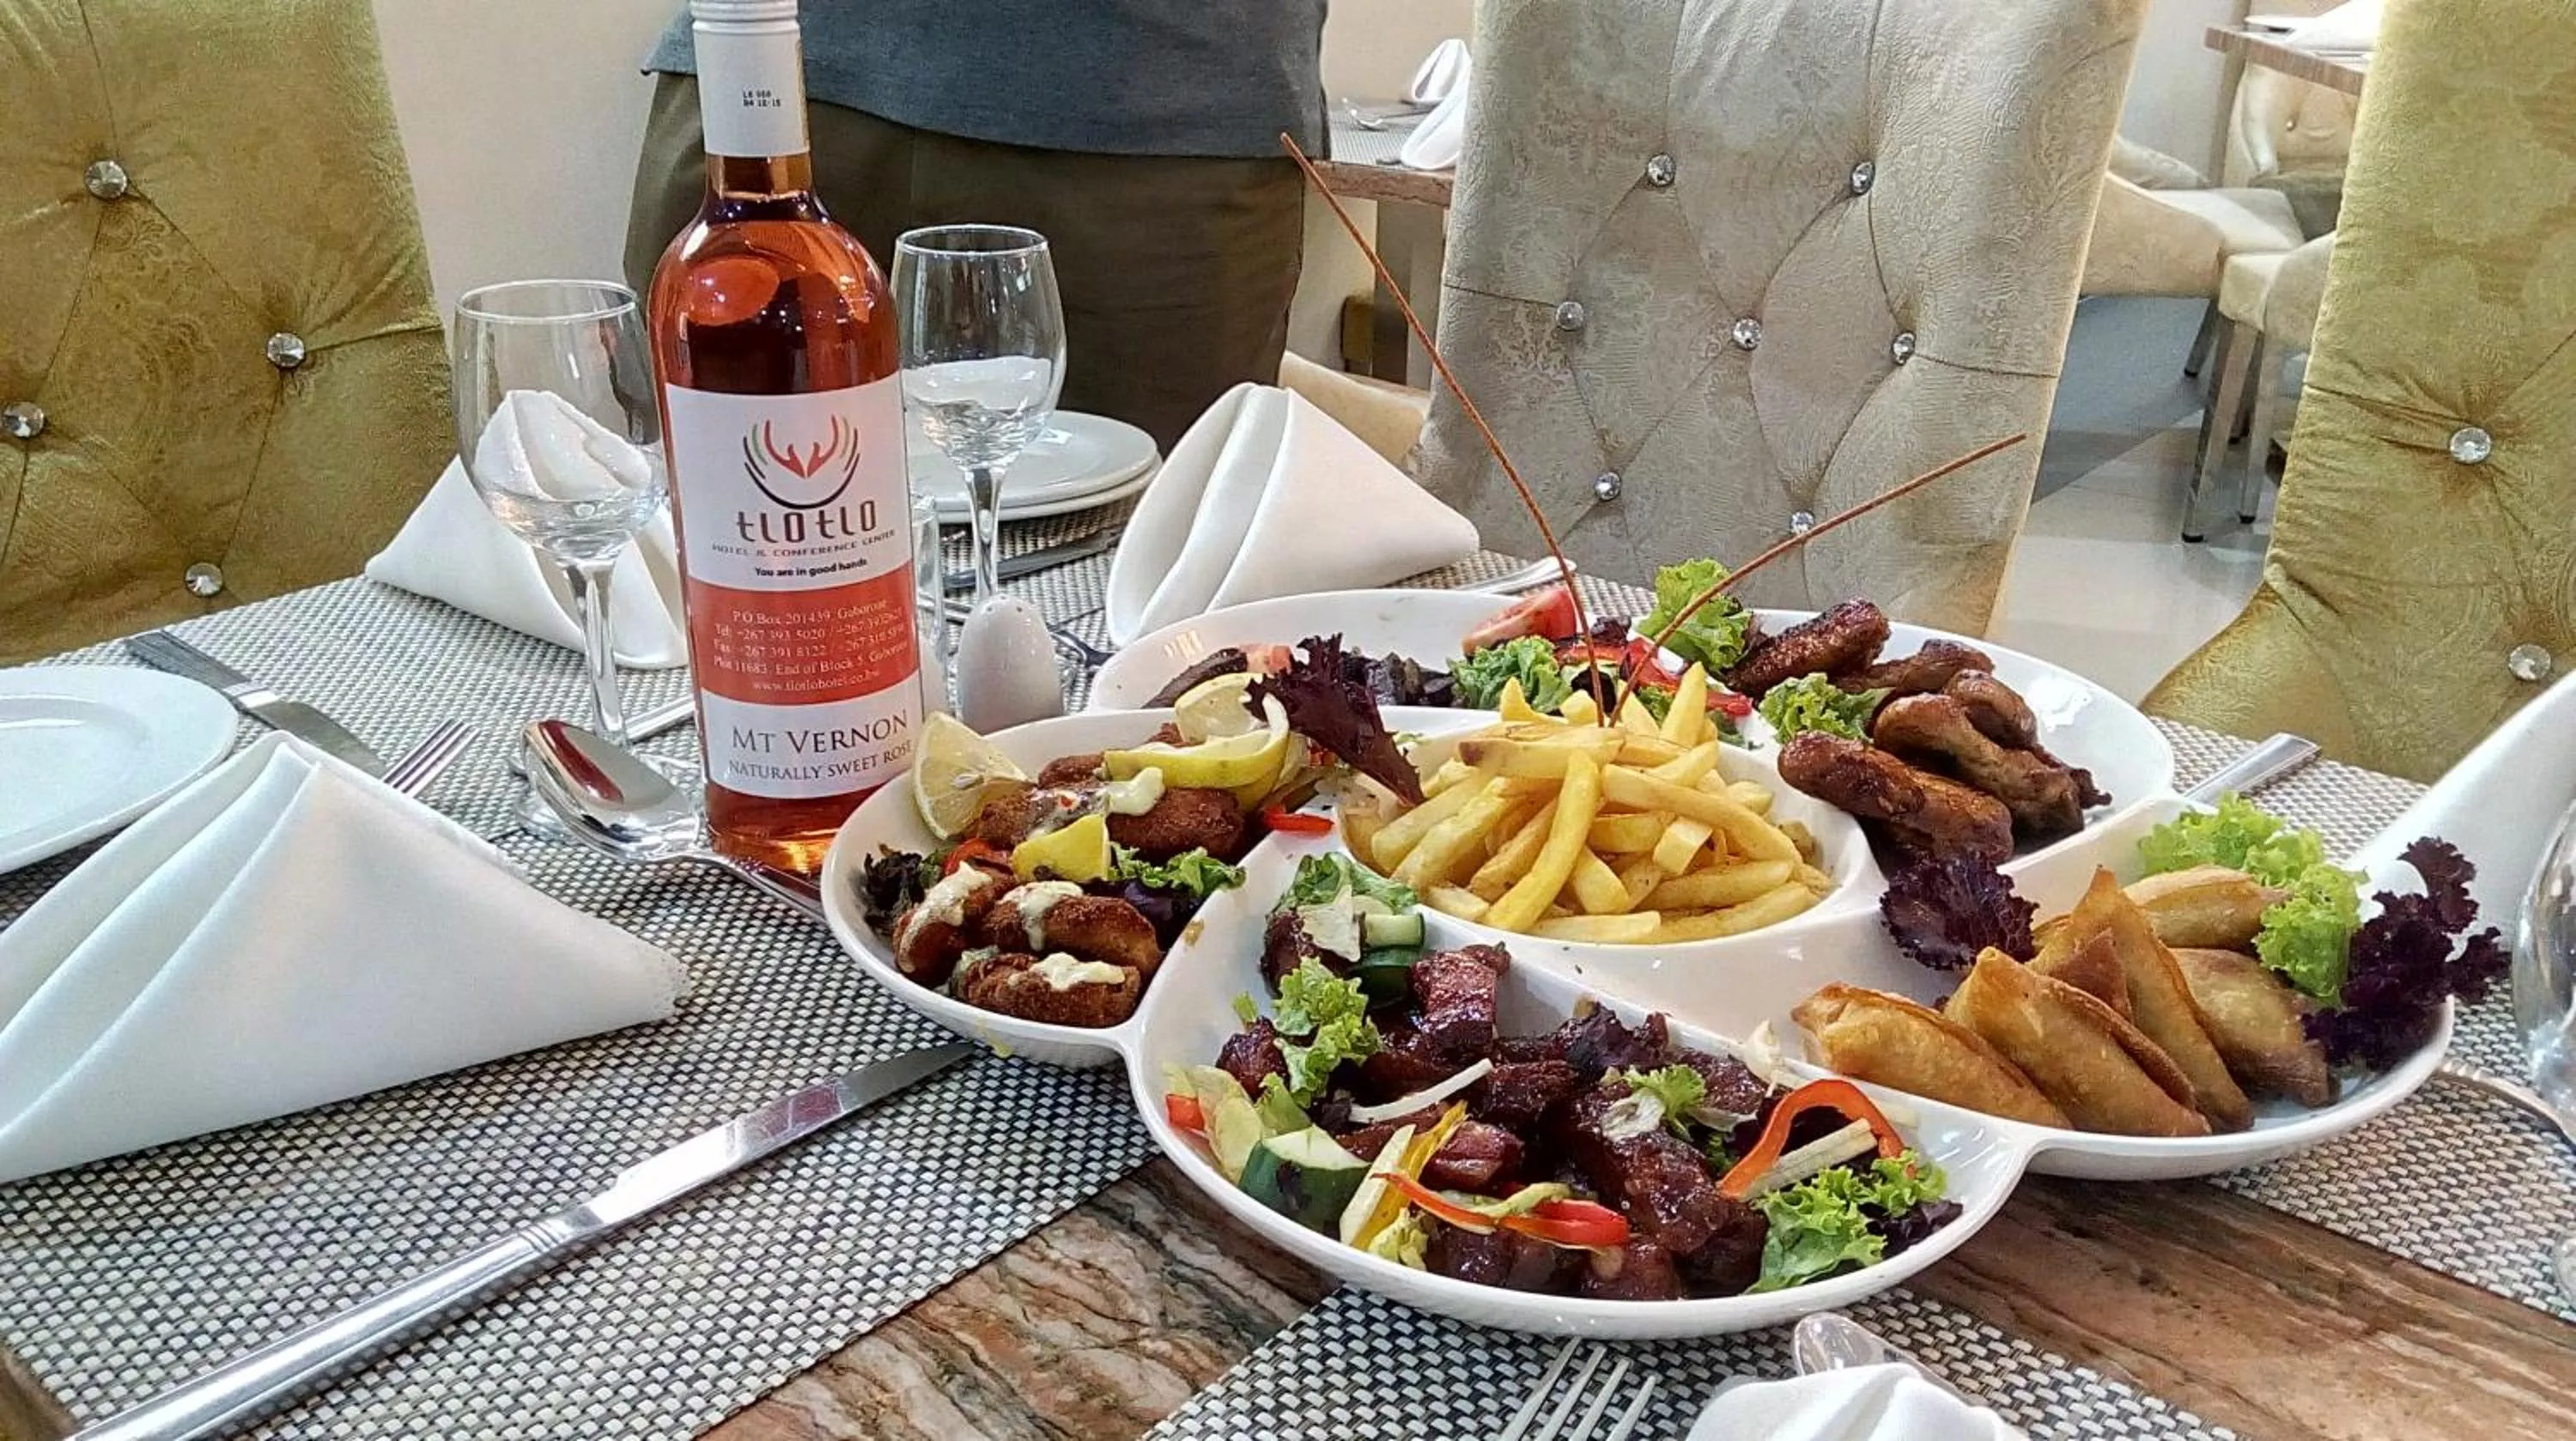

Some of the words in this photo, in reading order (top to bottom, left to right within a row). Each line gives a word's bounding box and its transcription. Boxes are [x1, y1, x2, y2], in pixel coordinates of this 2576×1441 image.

[774, 540, 857, 557] CONFERENCE
[755, 567, 774, 578] You
[776, 568, 793, 577] are
[796, 567, 807, 577] in
[809, 562, 837, 577] good
[775, 662, 801, 675] End
[803, 660, 818, 674] of
[821, 656, 854, 672] Block
[729, 759, 823, 781] NATURALLY
[827, 754, 879, 778] SWEET
